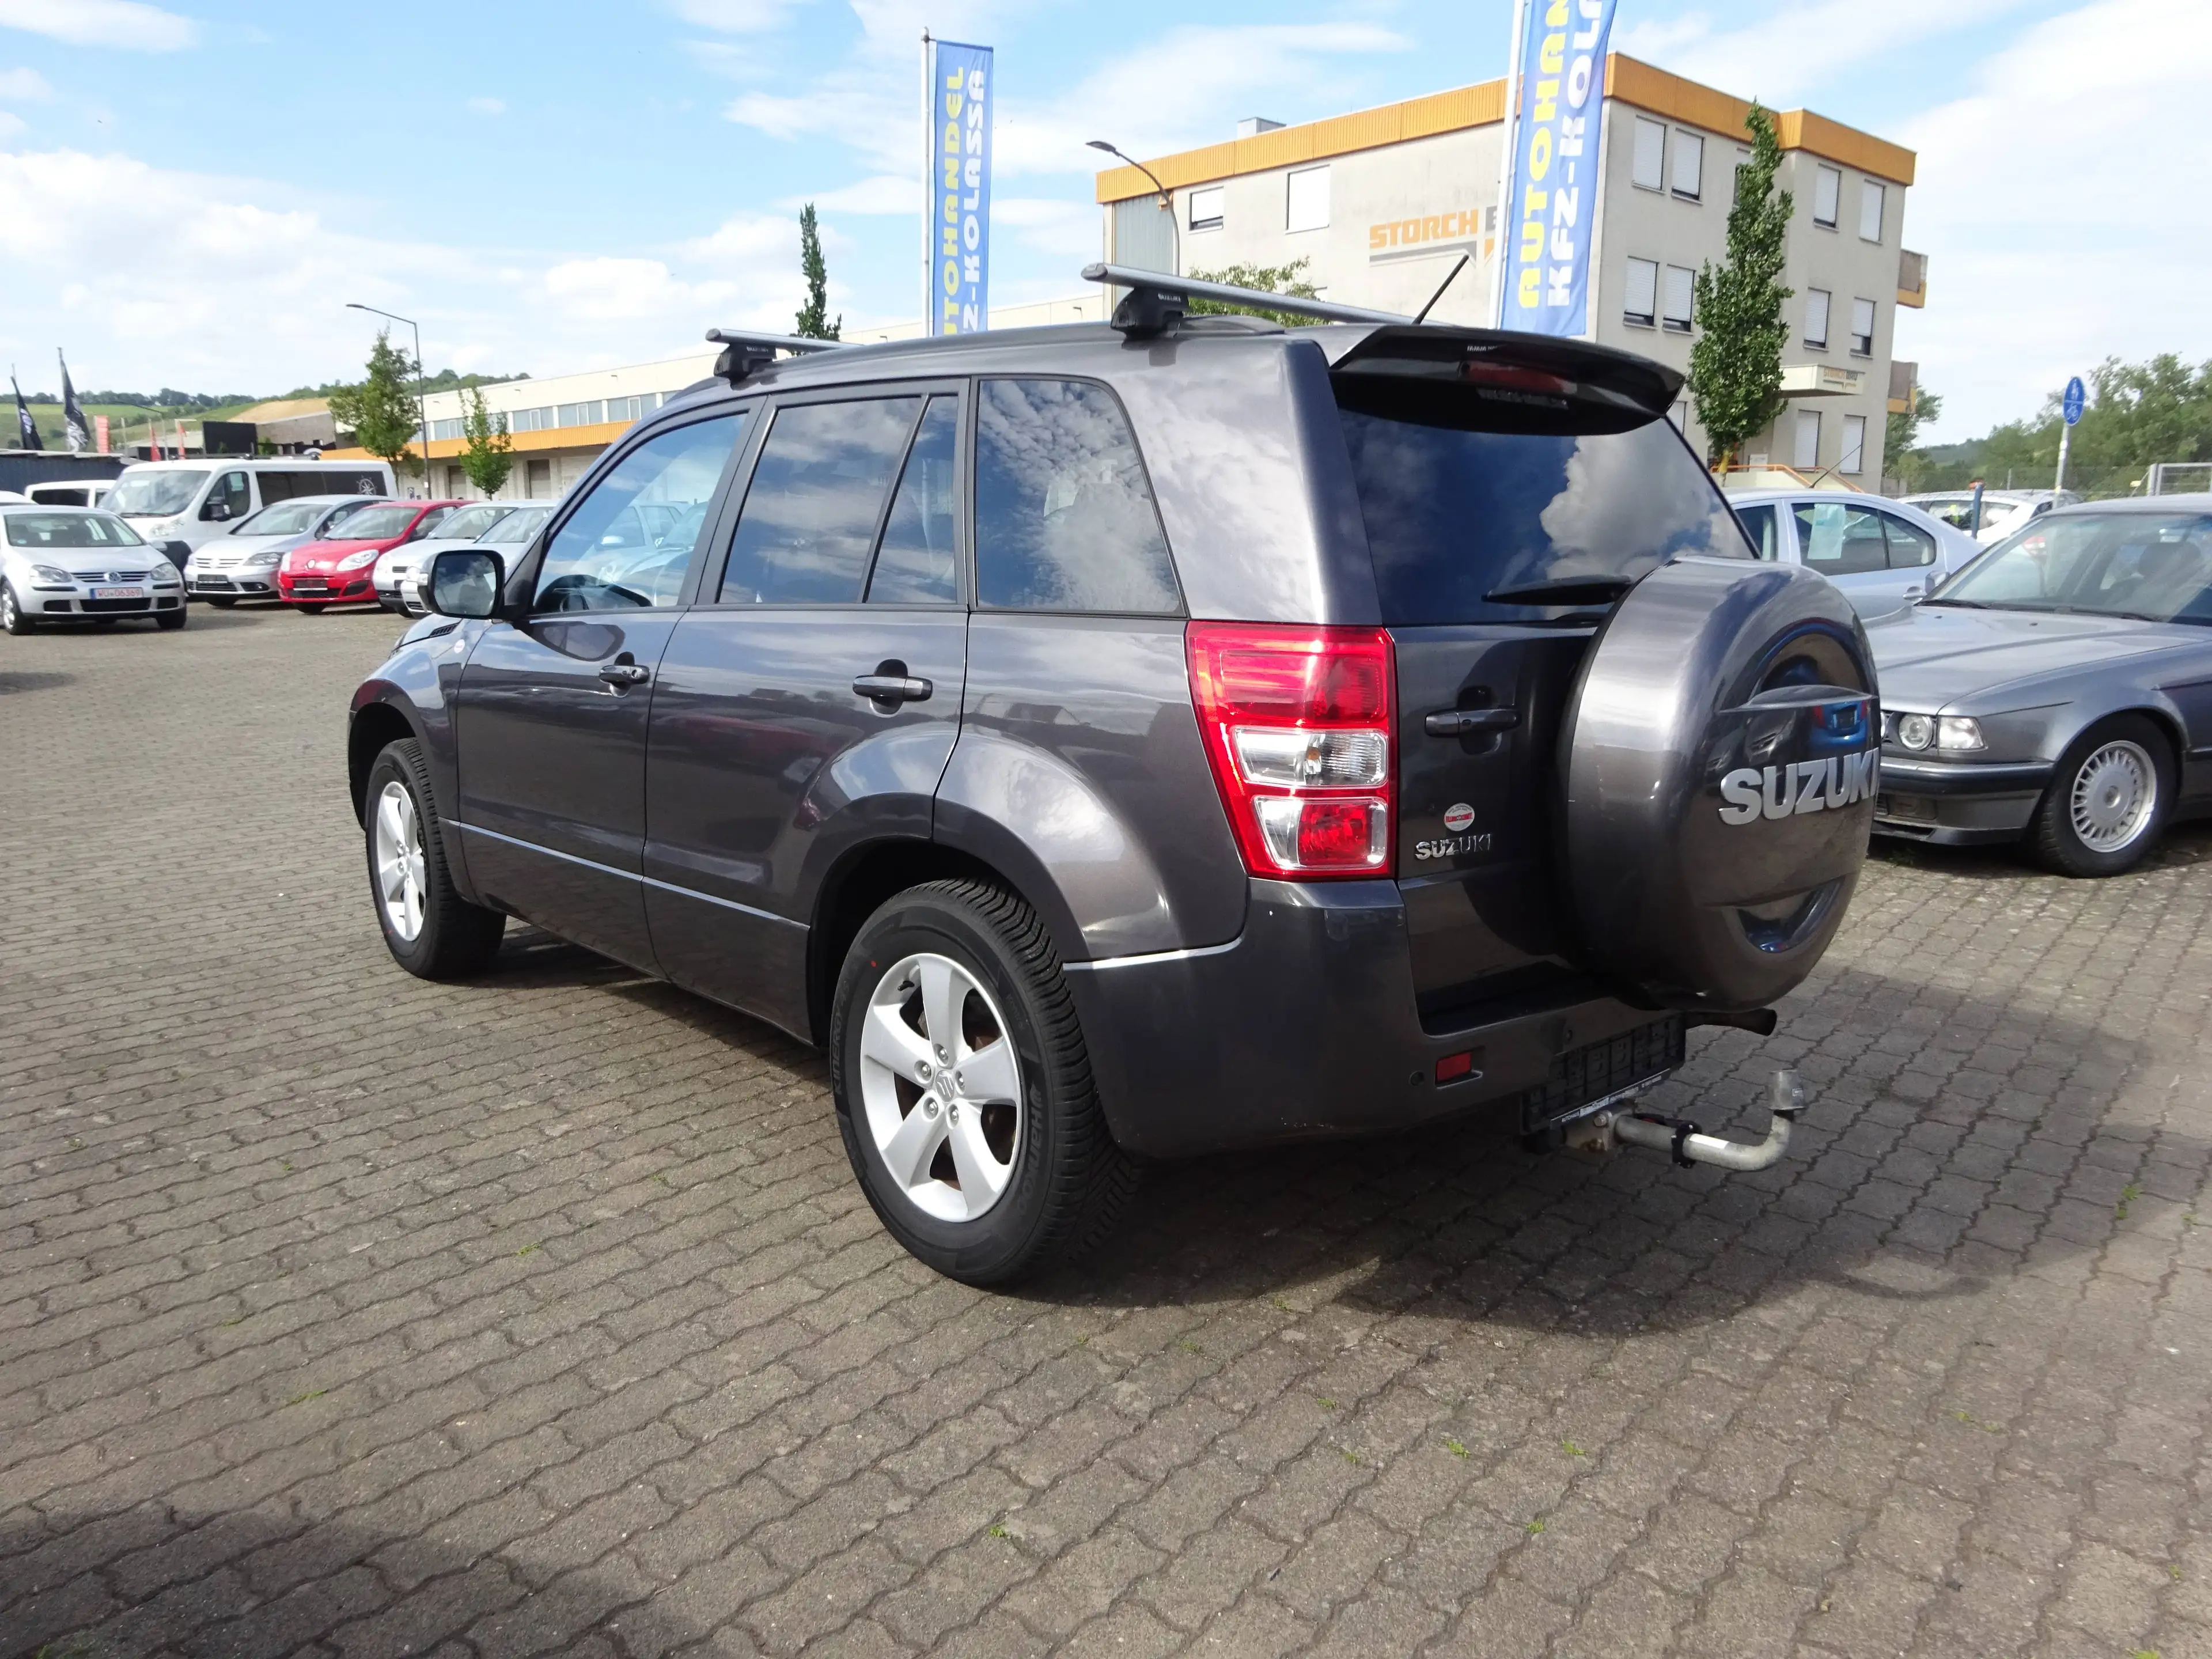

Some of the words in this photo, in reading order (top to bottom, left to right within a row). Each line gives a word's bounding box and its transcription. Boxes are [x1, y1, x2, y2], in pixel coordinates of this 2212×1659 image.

[963, 70, 984, 333] Z-KOLASSA
[1370, 209, 1478, 249] STORCH
[1718, 747, 1879, 825] SUZUKI
[1415, 834, 1491, 859] SUZUKI
